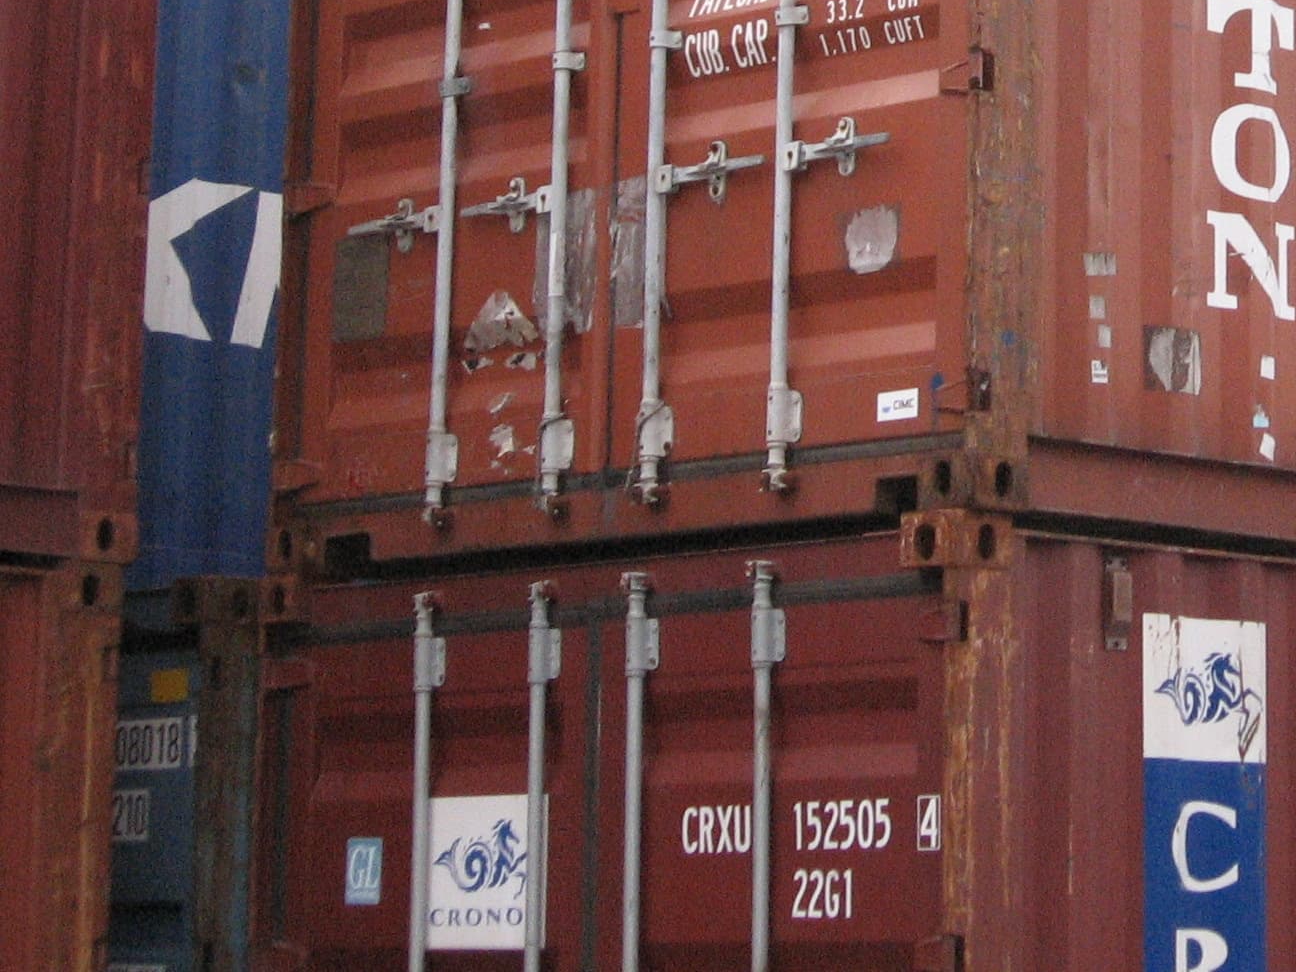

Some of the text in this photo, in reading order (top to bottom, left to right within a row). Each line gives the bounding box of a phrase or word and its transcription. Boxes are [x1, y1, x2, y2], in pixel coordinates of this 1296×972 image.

[684, 28, 730, 79] CUB.
[731, 18, 776, 69] CAP.
[883, 14, 926, 45] CUFT
[682, 798, 939, 854] CRXU 152505 4
[791, 869, 853, 919] 22G1
